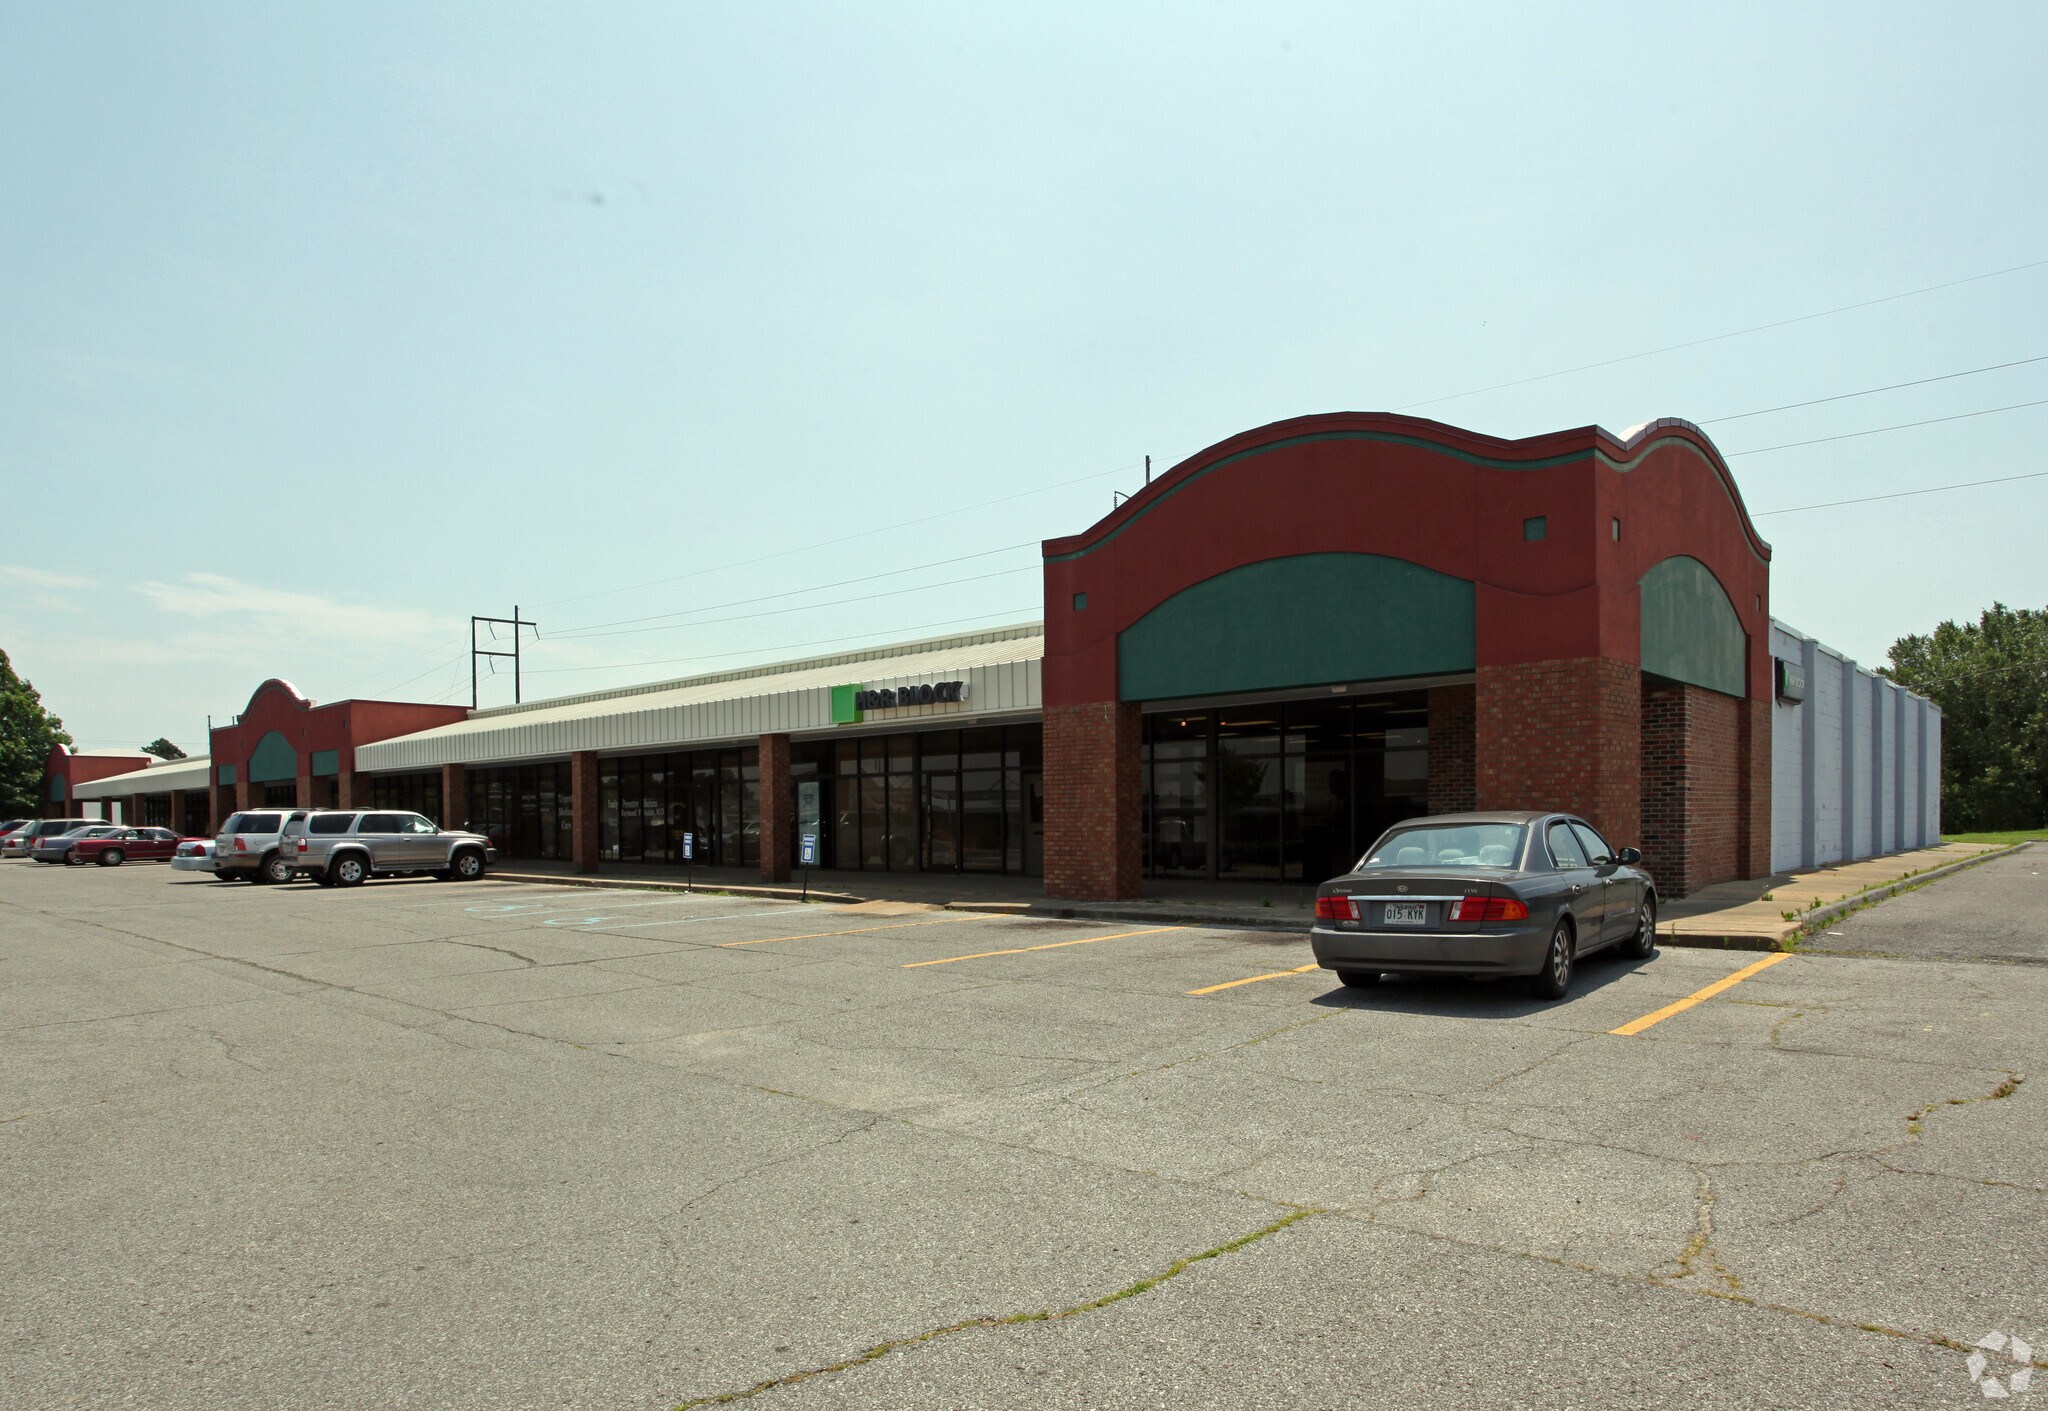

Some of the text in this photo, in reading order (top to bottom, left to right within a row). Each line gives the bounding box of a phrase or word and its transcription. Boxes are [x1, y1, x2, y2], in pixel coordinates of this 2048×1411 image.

[855, 681, 963, 710] H&R BLOCK
[1386, 909, 1424, 920] 015 KYK
